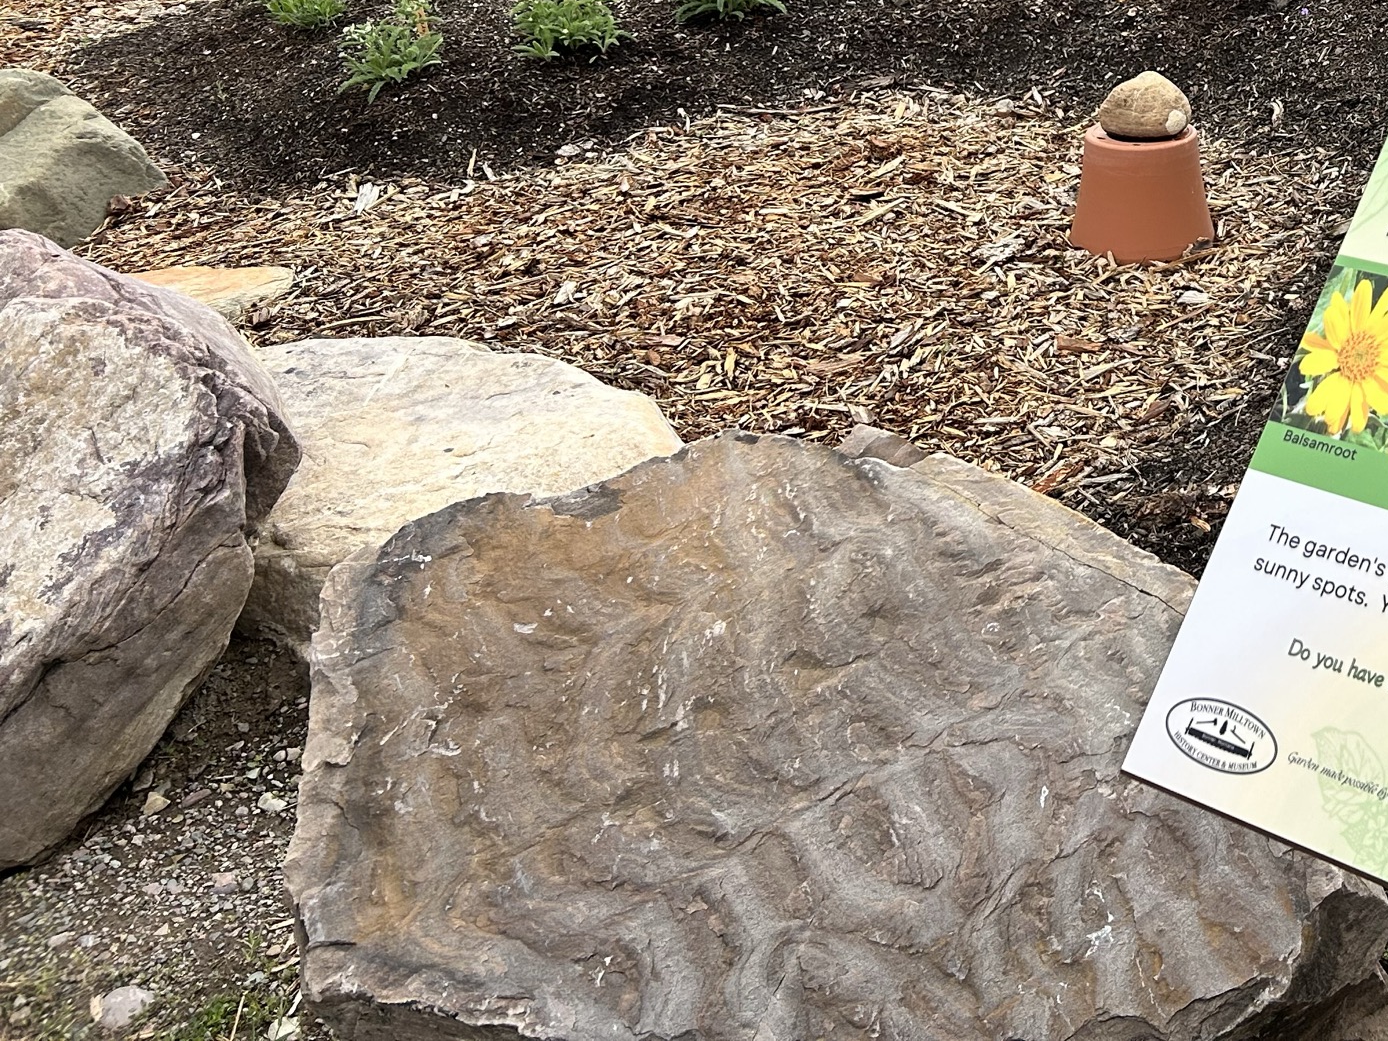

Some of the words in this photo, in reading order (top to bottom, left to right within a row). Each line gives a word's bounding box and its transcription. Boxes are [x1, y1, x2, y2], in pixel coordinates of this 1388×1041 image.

[1283, 430, 1358, 461] Balsamroot
[1268, 524, 1301, 549] The
[1302, 540, 1386, 577] garden's
[1254, 557, 1310, 589] sunny
[1312, 576, 1369, 607] spots.
[1288, 638, 1311, 660] Do
[1312, 652, 1343, 673] you
[1347, 658, 1385, 687] have
[1174, 730, 1196, 755] HISTORY
[1196, 752, 1220, 767] CENTER
[1228, 761, 1257, 770] MUSEUM
[1287, 752, 1320, 771] Garden
[1320, 765, 1345, 782] made
[1343, 776, 1379, 795] possible
